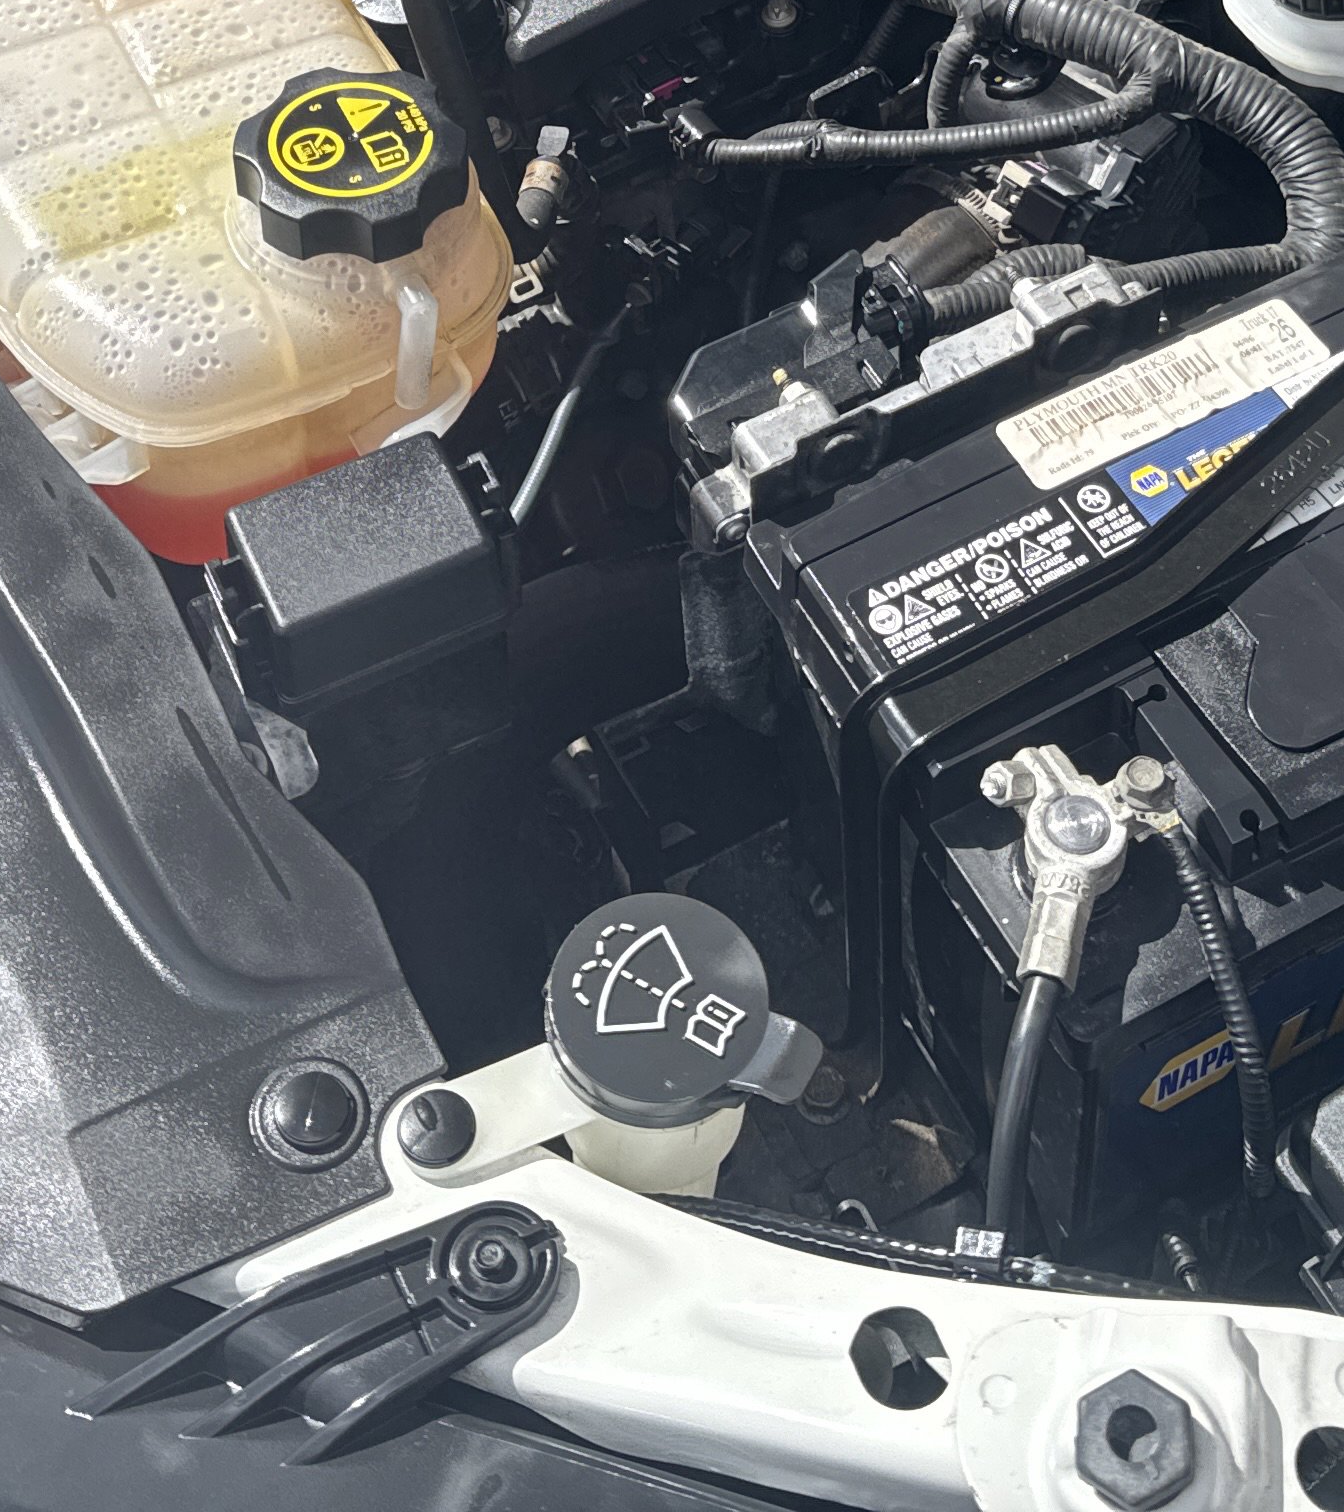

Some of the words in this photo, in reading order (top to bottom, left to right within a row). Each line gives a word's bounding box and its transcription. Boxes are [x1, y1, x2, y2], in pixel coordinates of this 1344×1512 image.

[1240, 311, 1267, 330] Truck
[1269, 318, 1297, 343] 26
[1012, 384, 1102, 432] PLYMOUTH
[1104, 374, 1128, 391] MN
[1130, 350, 1178, 378] TRK20
[1135, 472, 1165, 491] NAPA
[1086, 515, 1107, 530] KEEP
[1104, 508, 1121, 521] OUT
[1117, 502, 1129, 514] OF
[1096, 523, 1112, 538] THE
[1109, 513, 1135, 532] REACH
[1036, 521, 1075, 545] SULFURIC
[1051, 536, 1072, 552] ACID
[1099, 537, 1112, 549] OF
[1110, 523, 1147, 543] CHILDREN.
[882, 506, 1053, 599] DANGER/POISON
[1025, 563, 1044, 578] CAN
[1041, 552, 1068, 570] CAUSE
[1033, 560, 1077, 588] BLINDNESS
[1075, 554, 1089, 567] OR
[985, 578, 1017, 600] SPARKS
[991, 588, 1024, 610] FLAMES
[883, 616, 933, 648] EXPLOSIVE
[930, 605, 961, 629] GASES
[891, 644, 908, 659] CAN
[907, 633, 934, 652] CAUSE
[1156, 1038, 1236, 1103] NAPA
